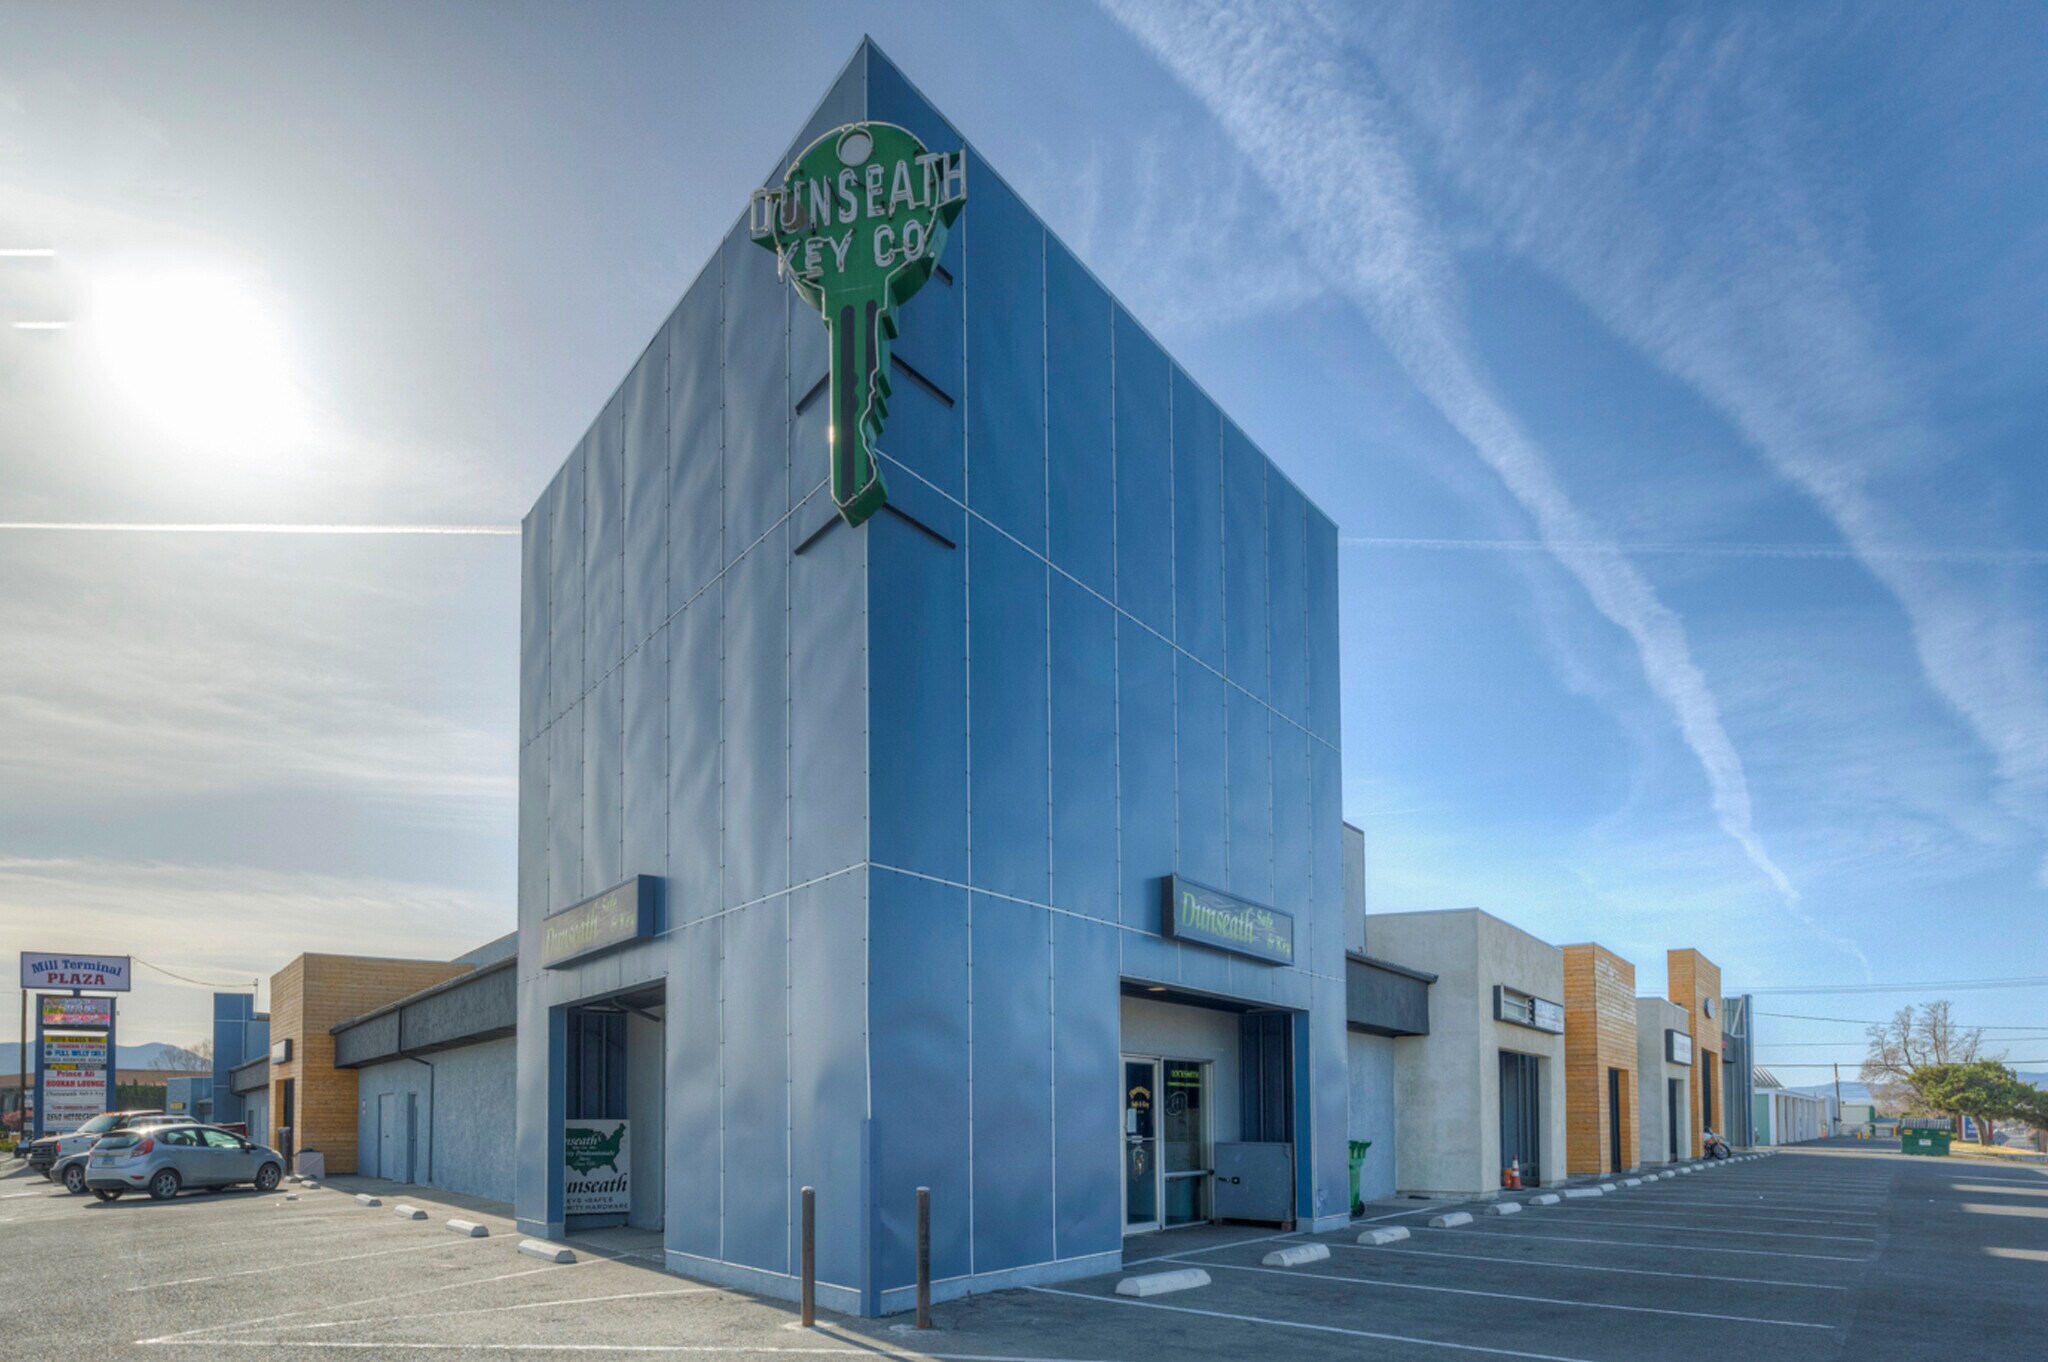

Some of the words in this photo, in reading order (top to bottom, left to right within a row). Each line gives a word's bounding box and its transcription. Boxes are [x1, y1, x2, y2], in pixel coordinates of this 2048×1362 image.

[750, 148, 967, 237] DUNSEATH
[777, 228, 856, 283] KEY
[874, 219, 936, 268] CO.
[1182, 891, 1254, 944] Dunseath
[31, 960, 58, 974] Mill
[62, 959, 122, 977] Terminal
[47, 972, 106, 985] PLAZA
